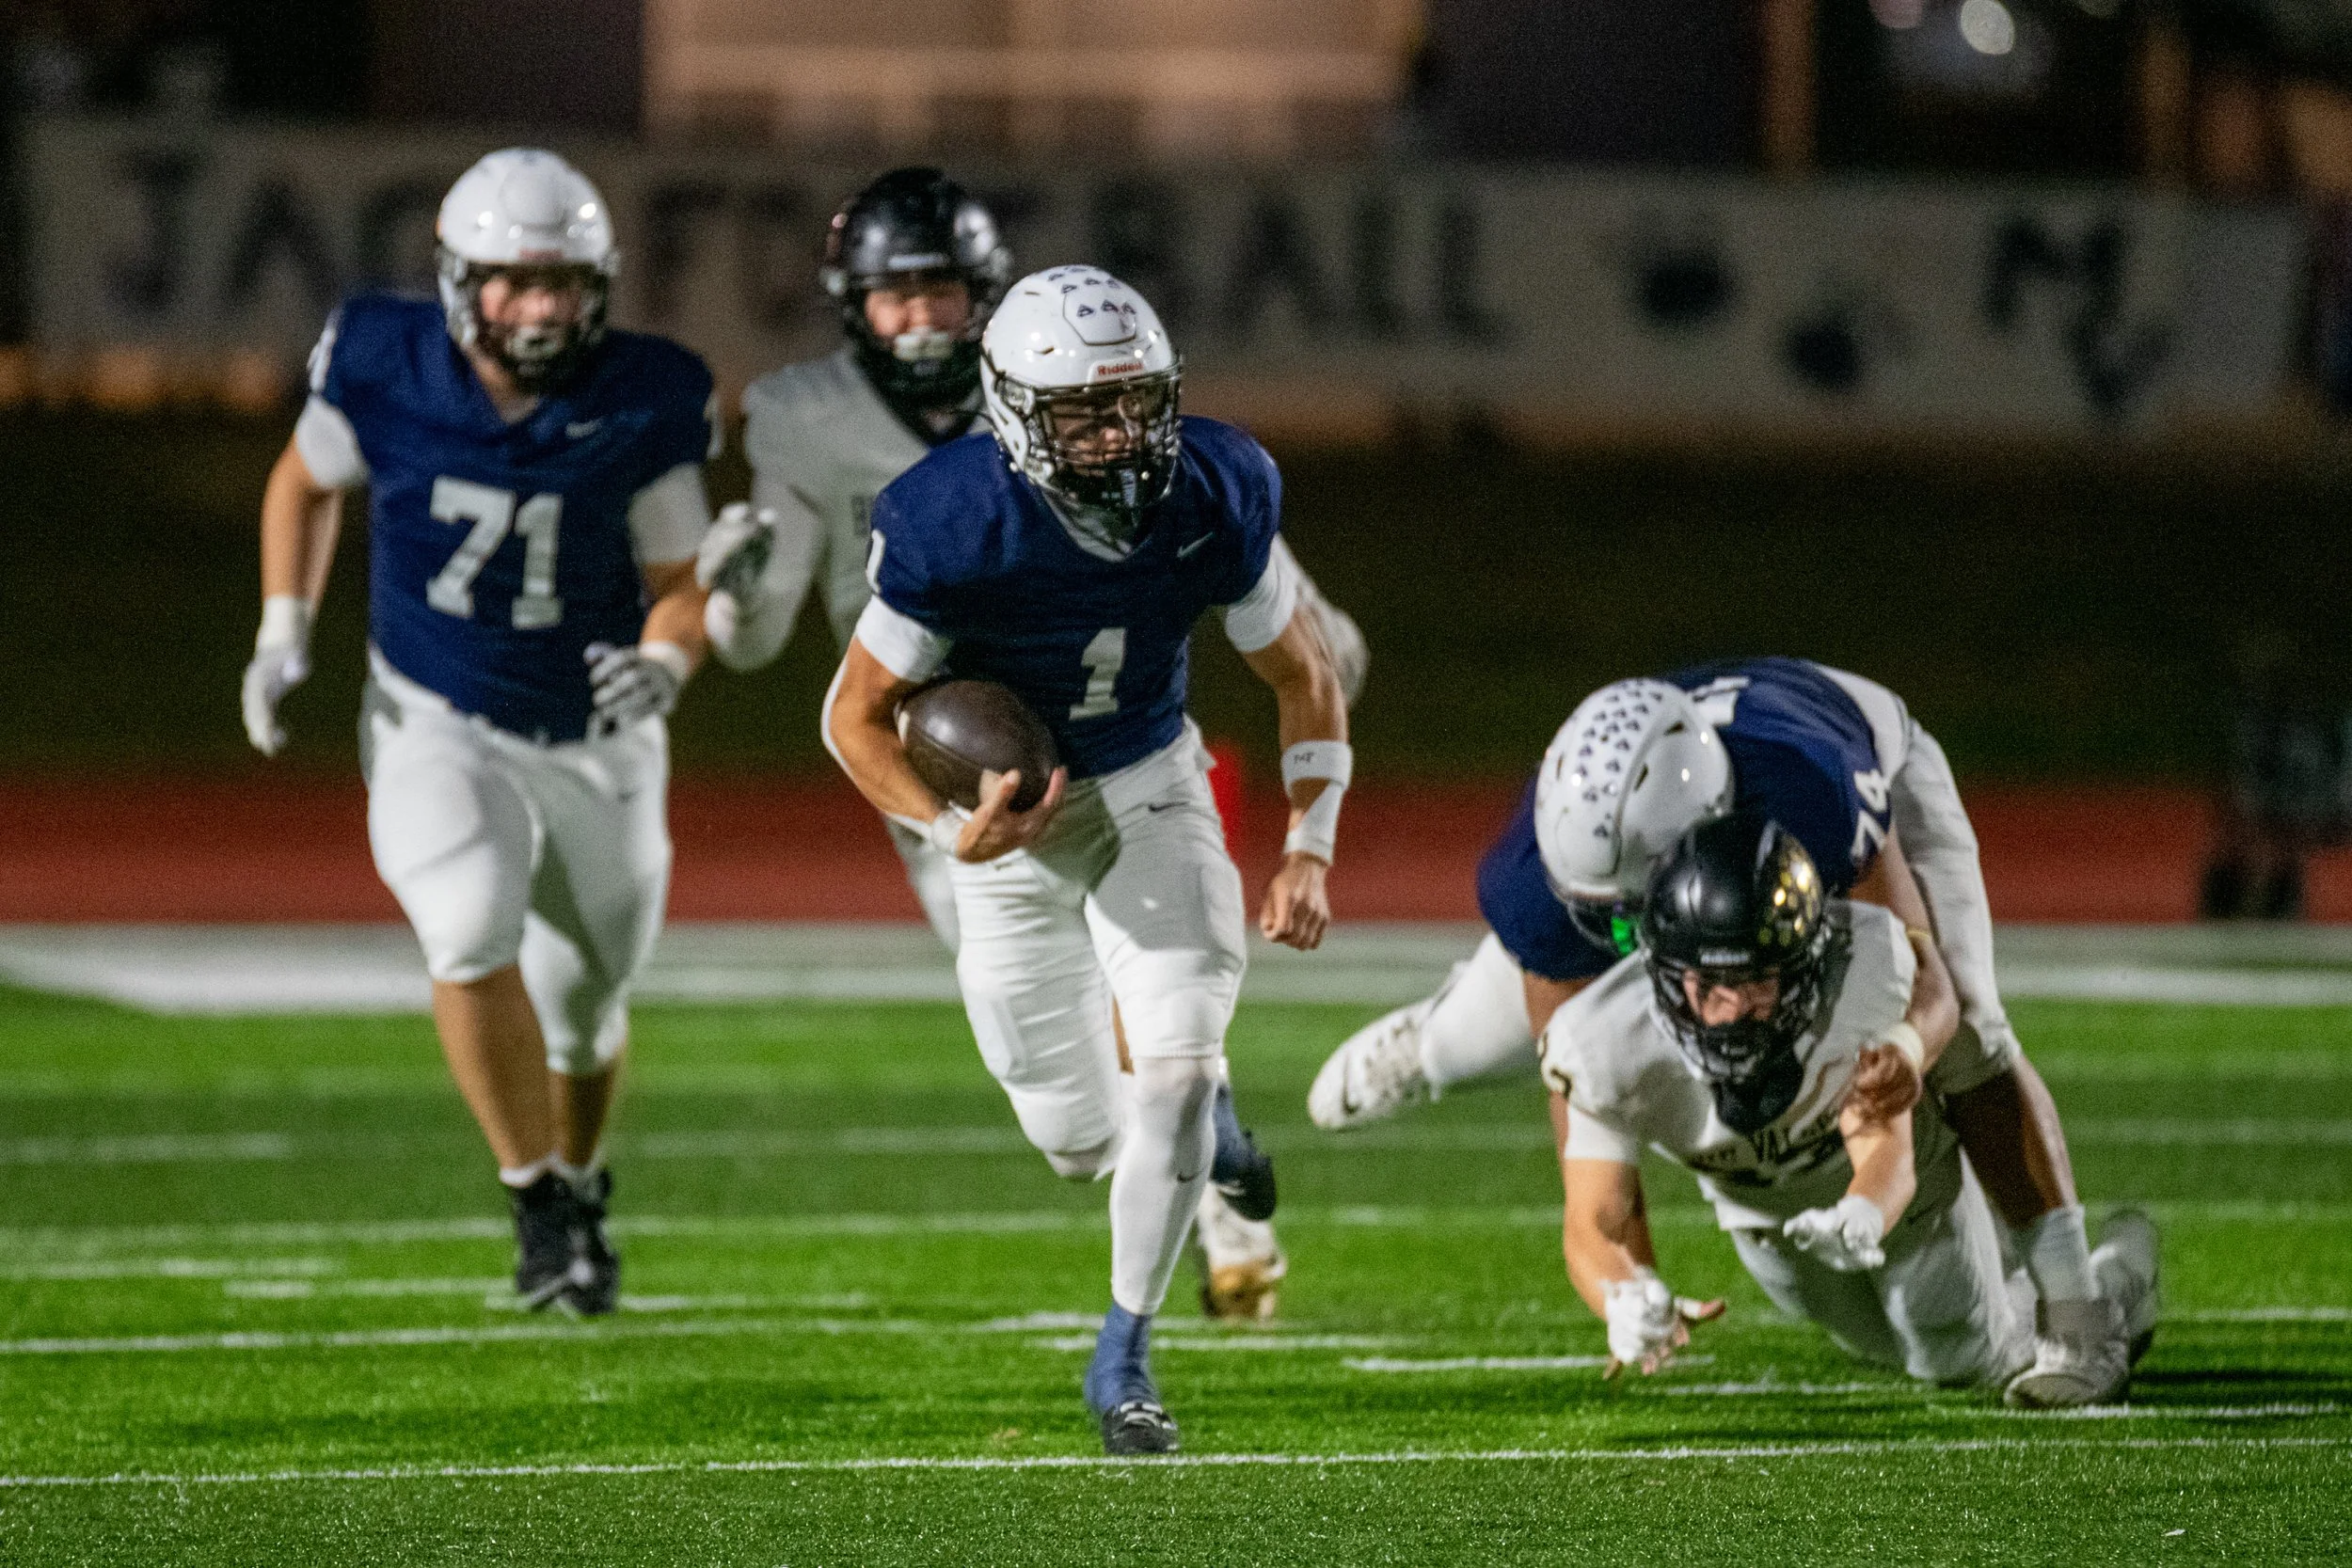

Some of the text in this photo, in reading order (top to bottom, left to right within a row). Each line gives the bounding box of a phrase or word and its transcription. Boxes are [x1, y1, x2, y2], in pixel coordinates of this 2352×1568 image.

[424, 474, 564, 631] 71
[1068, 626, 1126, 721] 1
[1850, 768, 1891, 858] 74
